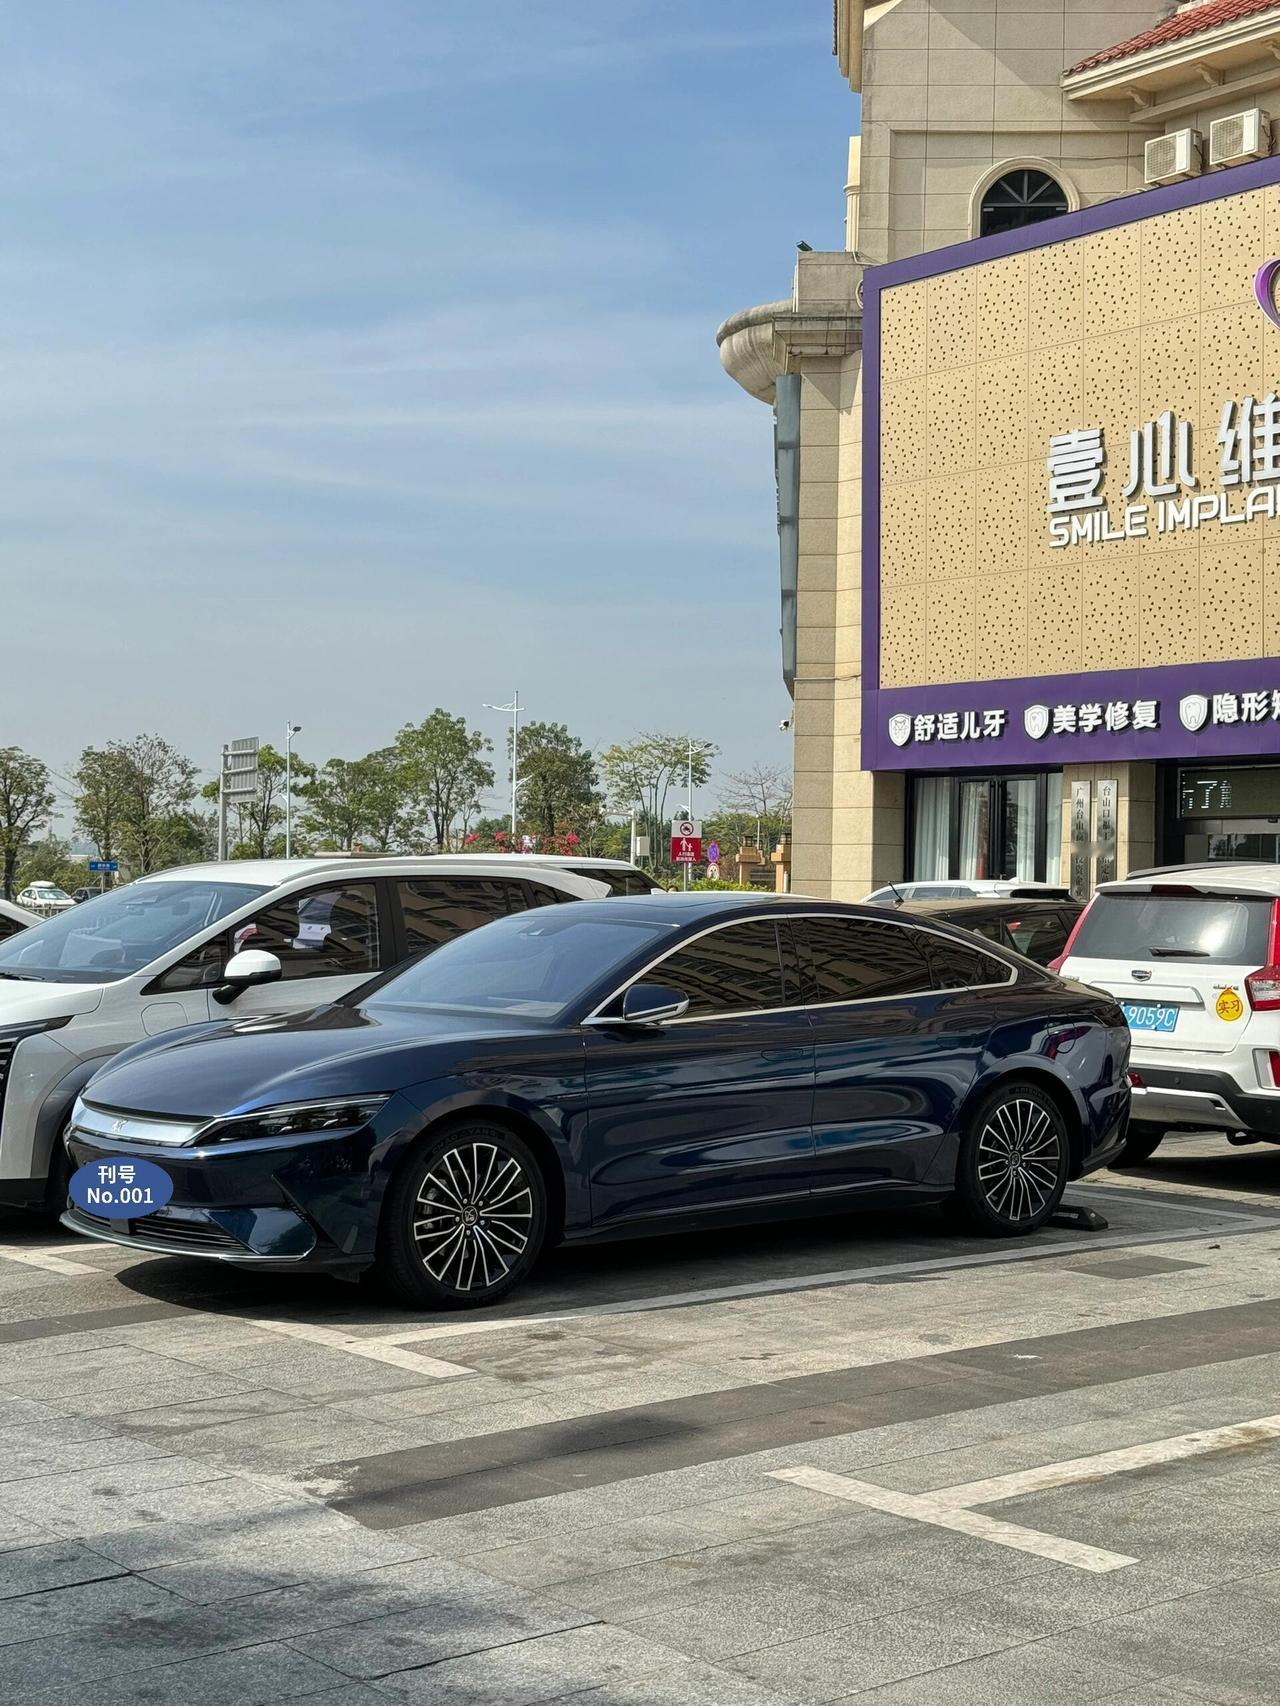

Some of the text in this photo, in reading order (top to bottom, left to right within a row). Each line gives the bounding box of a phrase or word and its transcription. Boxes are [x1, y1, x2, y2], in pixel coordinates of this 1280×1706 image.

[1047, 392, 1280, 512] 壹心维
[1049, 484, 1280, 547] SMILE IMPLA
[914, 709, 1005, 742] 舒适儿牙
[1053, 700, 1157, 734] 美学修复
[1122, 1006, 1175, 1027] 9059C
[1219, 1000, 1239, 1014] 实习
